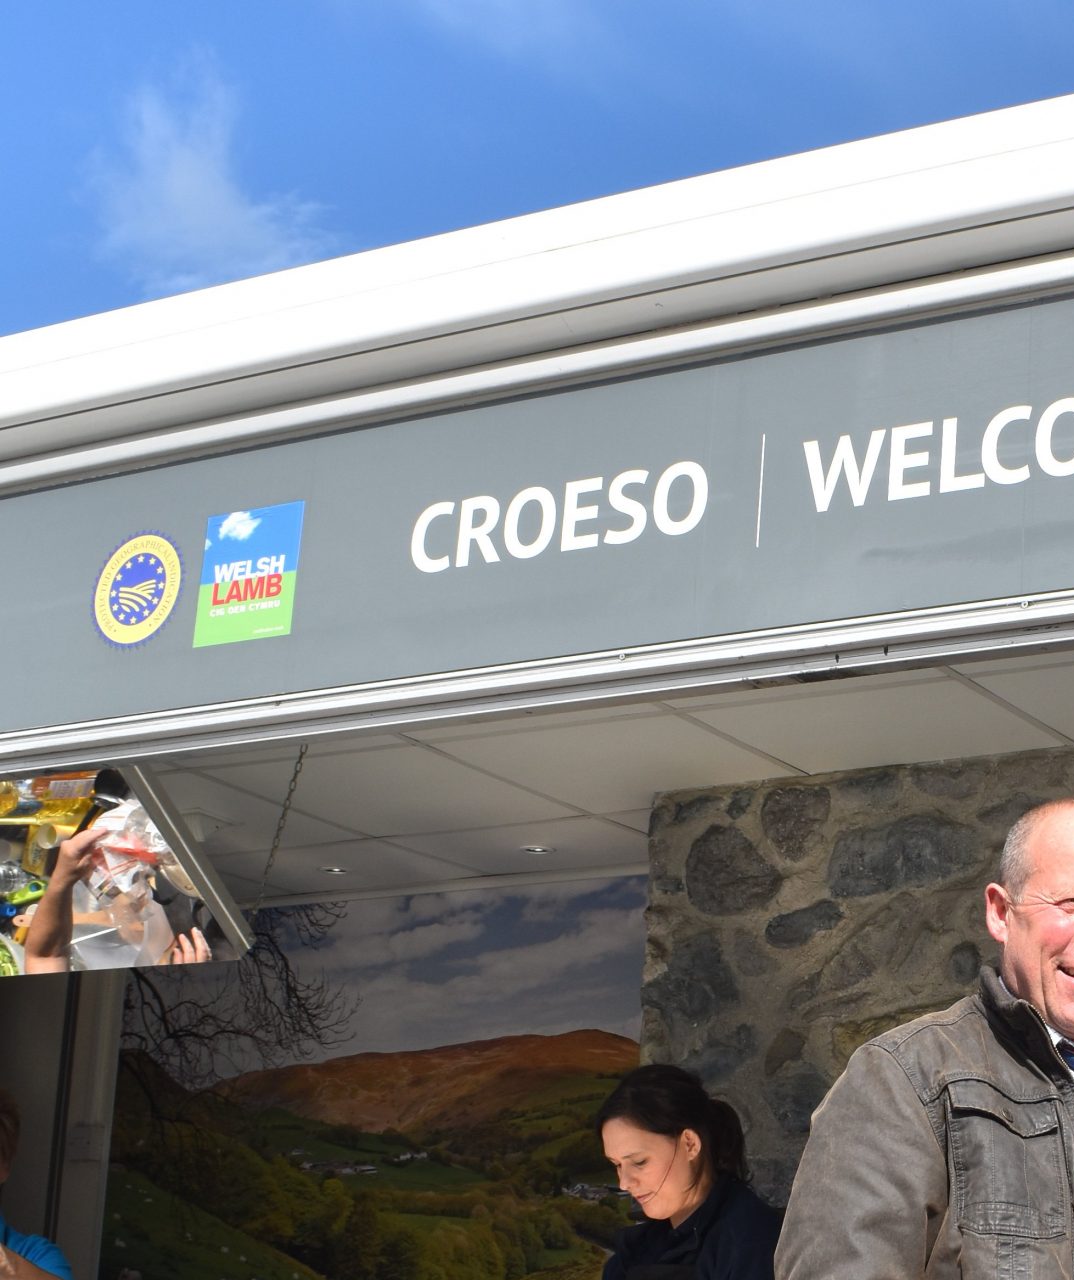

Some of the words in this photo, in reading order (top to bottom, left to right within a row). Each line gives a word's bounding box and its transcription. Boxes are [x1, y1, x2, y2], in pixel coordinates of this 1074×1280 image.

[410, 460, 709, 574] CROESO
[214, 554, 286, 583] WELSH
[212, 573, 282, 606] LAMB
